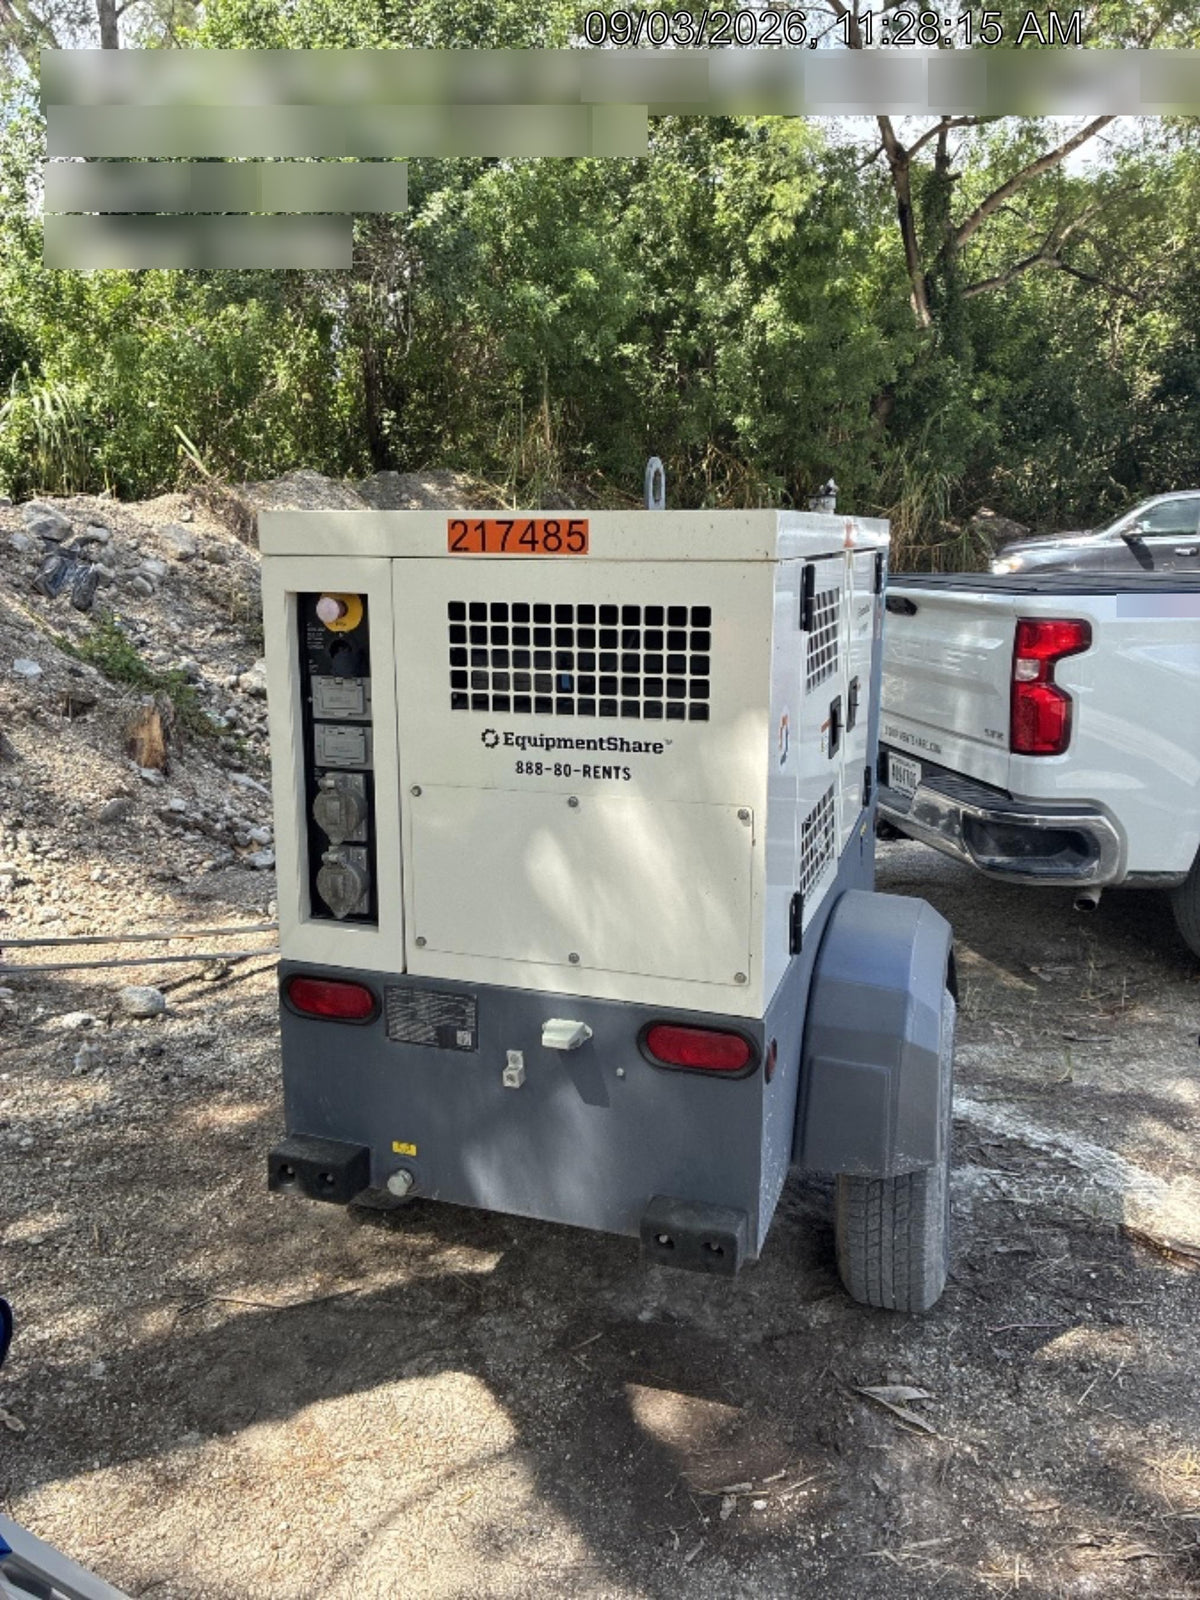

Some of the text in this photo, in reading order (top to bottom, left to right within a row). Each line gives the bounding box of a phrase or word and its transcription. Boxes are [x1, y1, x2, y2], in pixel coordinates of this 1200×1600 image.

[450, 520, 586, 552] 217485
[502, 732, 664, 754] EquipmentShare
[515, 760, 632, 781] 888-80-RENTS
